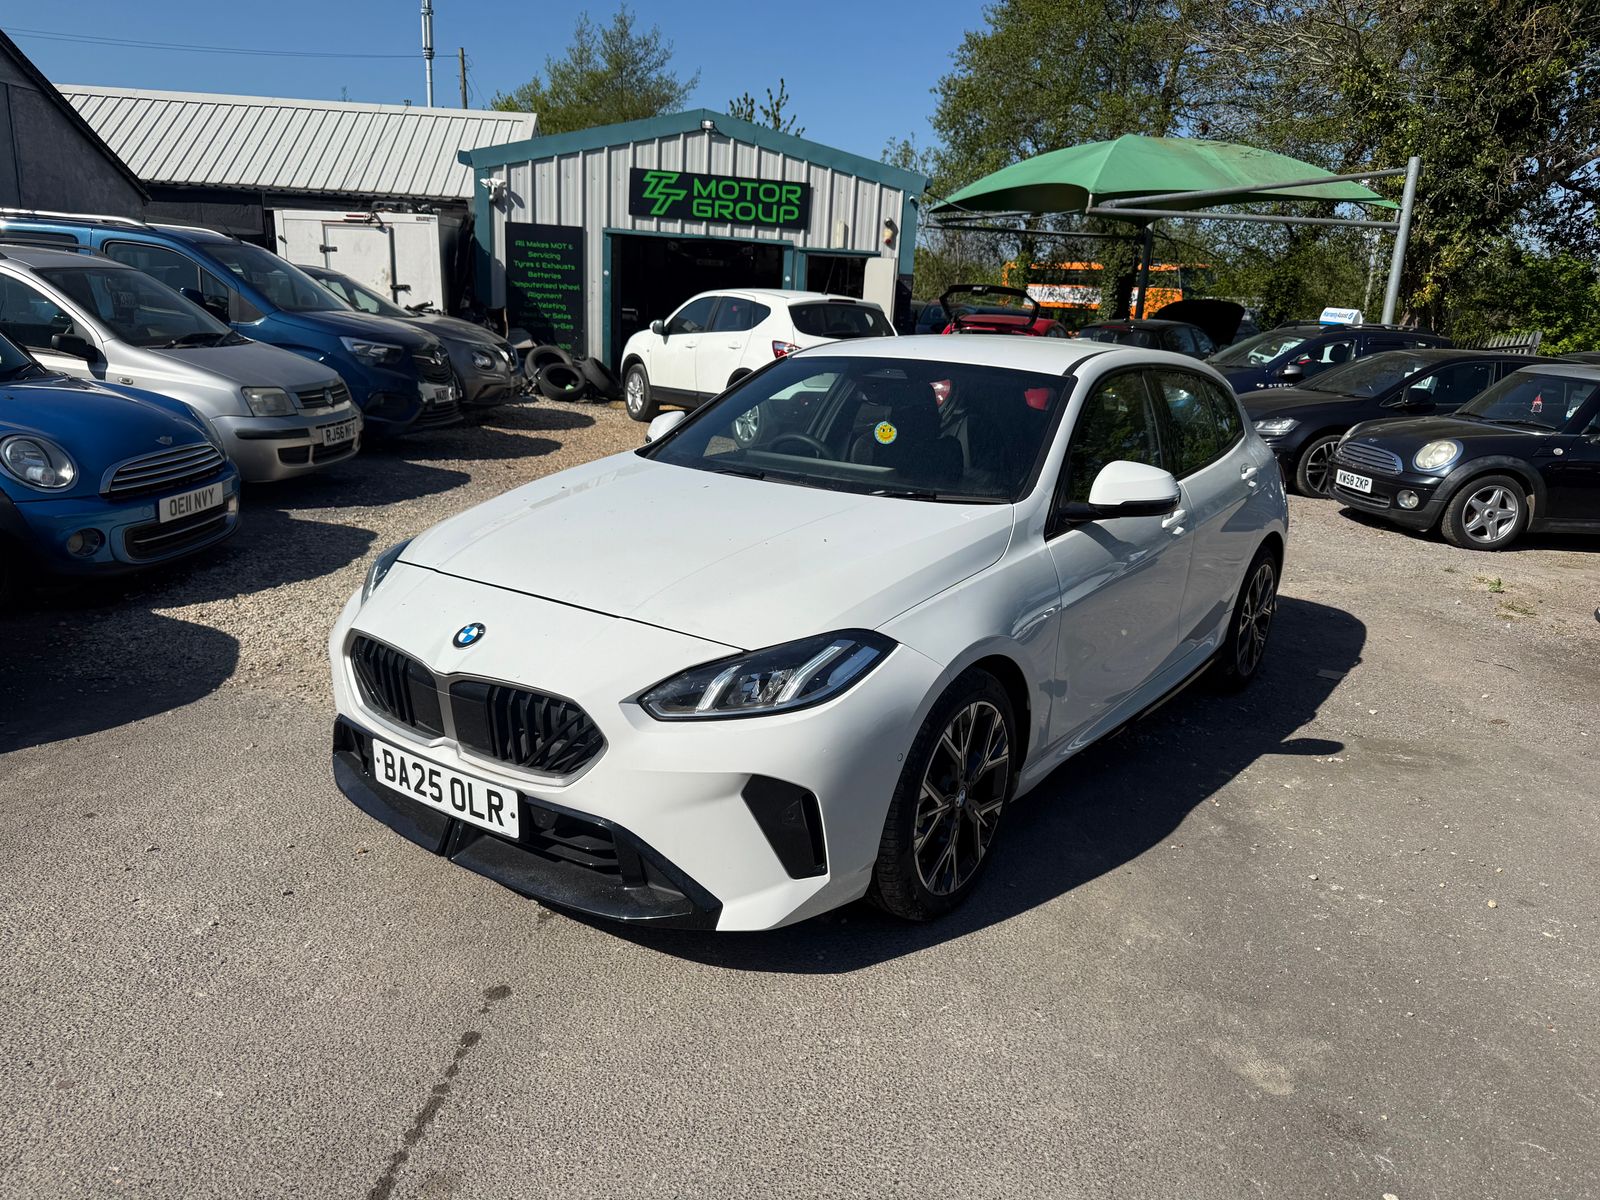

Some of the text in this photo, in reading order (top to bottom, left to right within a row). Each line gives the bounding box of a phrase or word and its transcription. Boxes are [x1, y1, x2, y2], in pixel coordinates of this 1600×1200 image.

[693, 178, 801, 204] MOTOR
[692, 199, 799, 223] GROUP
[527, 251, 561, 260] Servicing
[513, 260, 534, 268] Tyres
[542, 262, 576, 270] Exhausts
[527, 271, 561, 279] Batteries
[559, 283, 580, 291] Wheel
[527, 292, 562, 300] Alignment
[537, 302, 567, 311] Valeting
[326, 426, 345, 442] RJ56
[1339, 471, 1369, 490] KW58 ZKP
[194, 488, 214, 509] NVY
[382, 748, 504, 827] BA25 OLR
